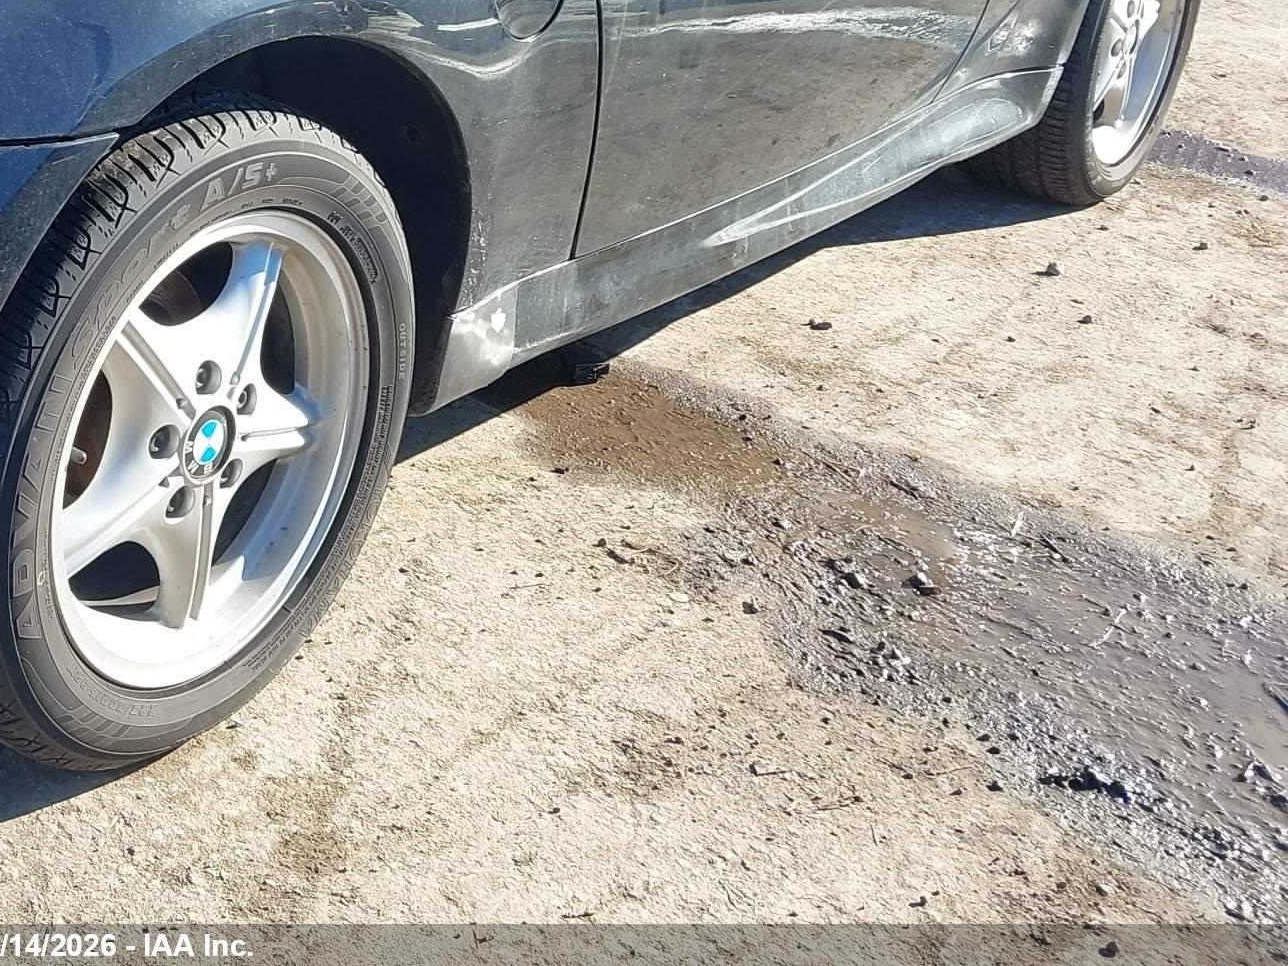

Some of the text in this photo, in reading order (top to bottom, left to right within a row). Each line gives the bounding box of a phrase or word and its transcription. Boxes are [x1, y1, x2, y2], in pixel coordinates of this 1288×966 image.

[13, 373, 73, 639] ADVAN
[199, 162, 278, 212] A/S+
[397, 322, 408, 382] OUTSIDE
